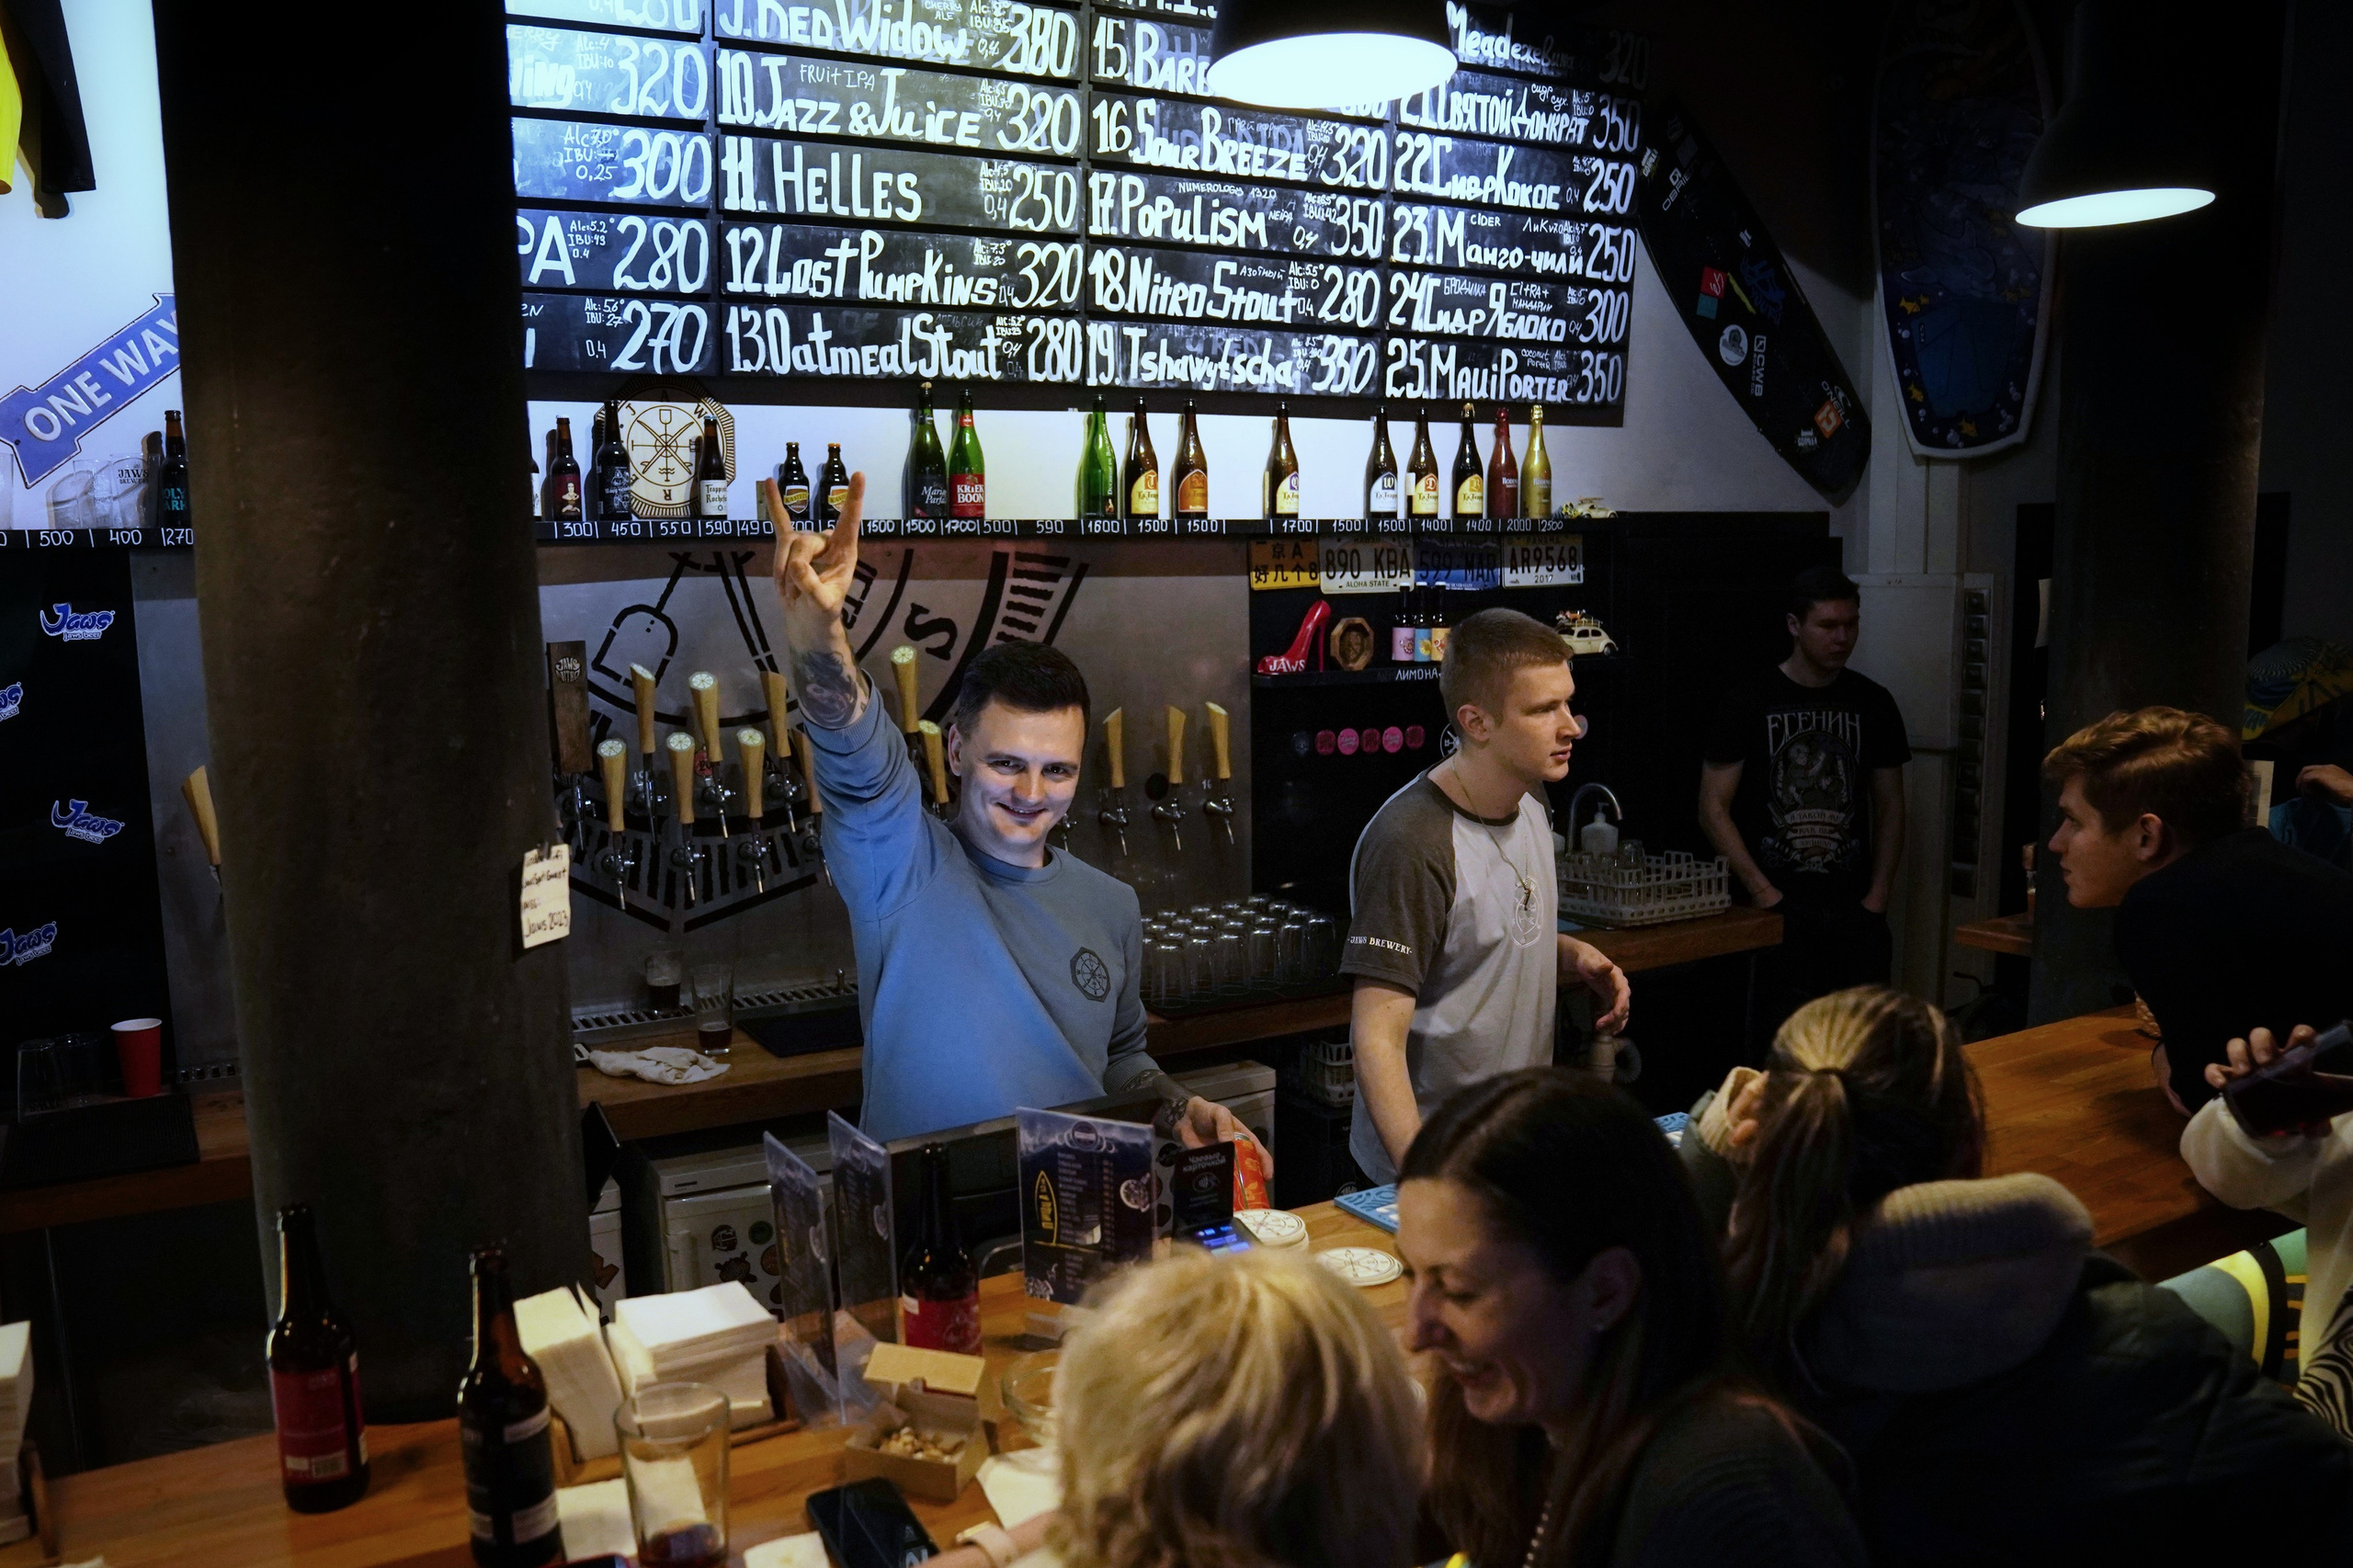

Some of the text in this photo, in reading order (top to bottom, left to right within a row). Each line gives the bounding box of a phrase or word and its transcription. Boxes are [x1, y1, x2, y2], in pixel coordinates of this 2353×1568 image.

[1002, 4, 1077, 77] 380
[1093, 17, 1131, 81] 15.
[610, 36, 708, 118] 320
[844, 70, 875, 92] IPA
[848, 101, 870, 136] &
[996, 83, 1081, 154] 320
[1511, 86, 1590, 144] ДОМКРАТ
[1593, 93, 1642, 153] 350
[1092, 98, 1135, 158] 16.
[1200, 106, 1308, 181] BREEZE
[1321, 126, 1387, 189] 320
[575, 129, 712, 201] 0,25 300
[1178, 181, 1277, 199] NUMEROLOGY 1320
[1583, 157, 1635, 215] 250
[1010, 165, 1077, 232] 250
[1088, 172, 1118, 235] 17.
[1331, 196, 1384, 258] 350
[572, 248, 590, 258] 0.4
[613, 216, 709, 293] 280
[1436, 209, 1583, 276] Манго-чили
[1586, 223, 1635, 282] 250
[1011, 242, 1084, 308] 320
[1318, 265, 1381, 327] 280
[1578, 289, 1629, 344] 300
[610, 300, 709, 375] 270
[585, 339, 607, 359] 0.4
[912, 312, 1002, 380] Stout
[1027, 317, 1083, 382] 280
[1086, 323, 1376, 393] 19. Tshawytscha 350
[1385, 337, 1430, 399] 25.
[1498, 348, 1573, 403] PORTER
[1577, 349, 1622, 403] 350
[24, 370, 112, 441] ONE
[958, 493, 984, 504] BOON
[563, 522, 593, 537] 300
[610, 522, 642, 536] 450
[660, 521, 691, 535] 550
[705, 520, 733, 535] 590
[740, 520, 774, 535] 490
[867, 520, 895, 533] 1500
[905, 520, 936, 533] 1500
[945, 520, 976, 534] 1700
[983, 520, 1010, 533] 500
[1036, 520, 1063, 534] 590
[1087, 520, 1120, 533] 1600
[1138, 519, 1168, 532] 1500
[1188, 519, 1219, 532] 1500
[1282, 519, 1313, 533] 1700
[1333, 519, 1361, 532] 1500
[1378, 520, 1405, 532] 1500
[1420, 519, 1448, 531] 1400
[1466, 520, 1492, 531] 1400
[1506, 518, 1531, 531] 2000
[1540, 519, 1563, 531] 2500
[40, 530, 74, 546] 500
[109, 528, 142, 545] 400
[166, 528, 194, 546] 270
[1325, 549, 1411, 579] 890 KBA
[1509, 546, 1578, 574] AR9568
[1534, 575, 1553, 584] 2017
[40, 602, 114, 636] Jaws
[1268, 658, 1305, 673] JAWS
